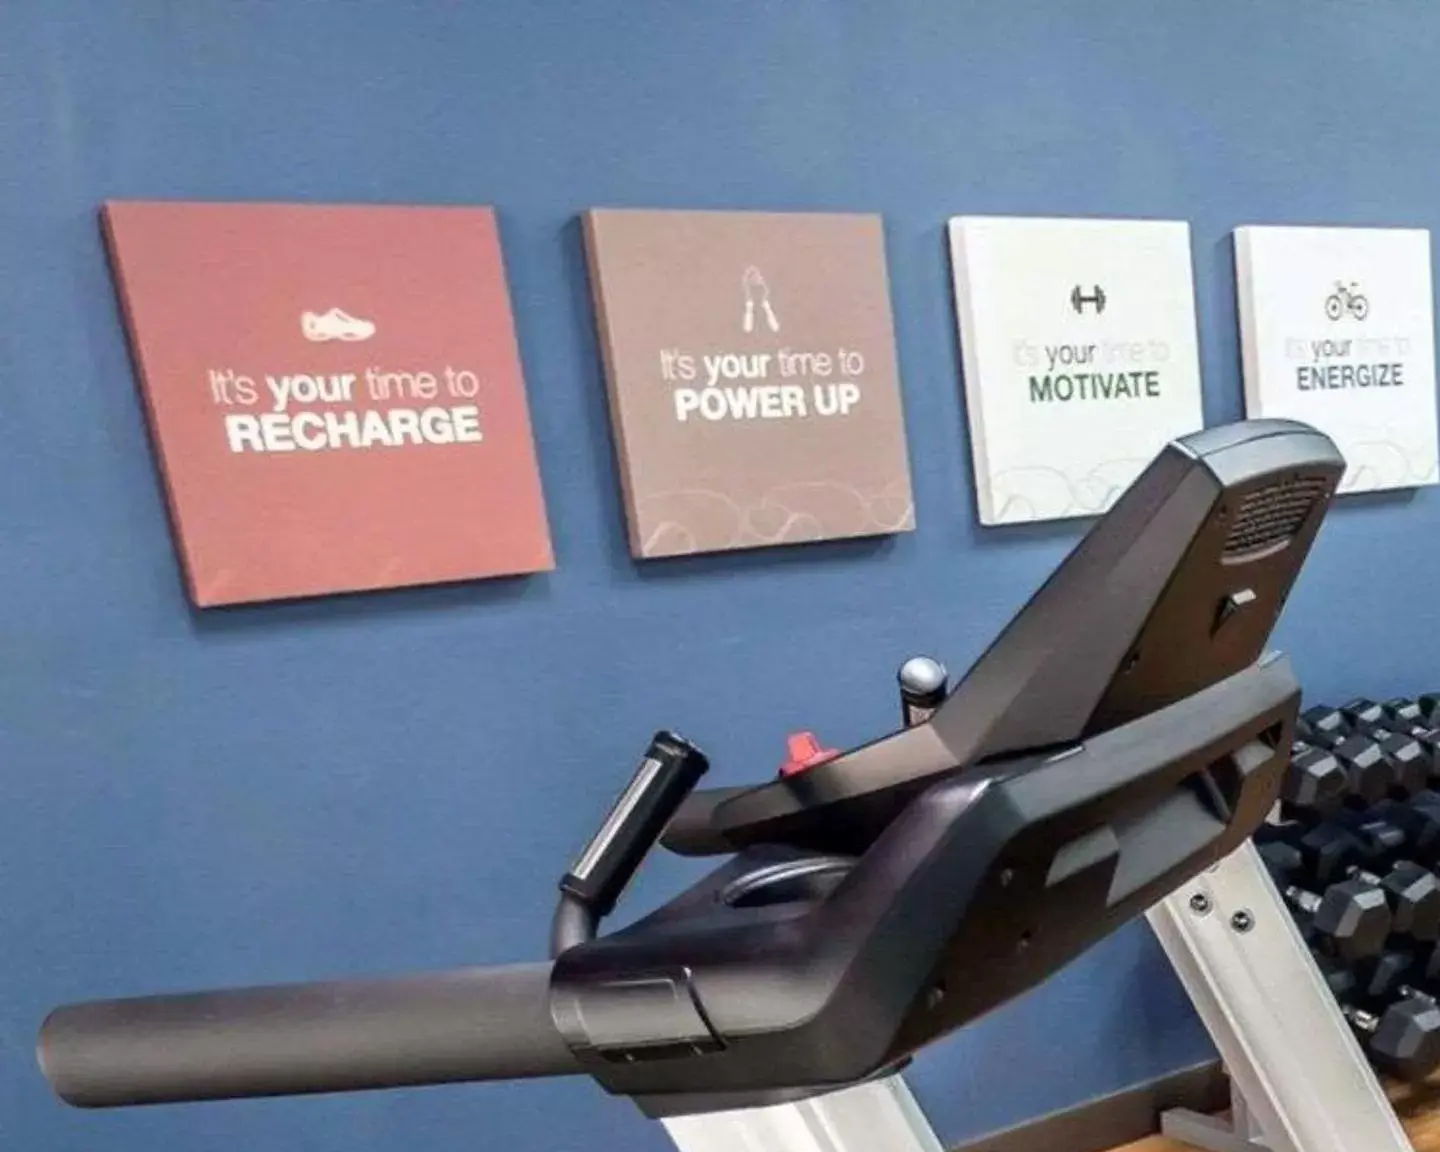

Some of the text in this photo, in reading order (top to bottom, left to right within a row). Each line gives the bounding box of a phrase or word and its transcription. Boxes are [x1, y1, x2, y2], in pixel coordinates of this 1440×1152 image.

[703, 352, 772, 386] your
[777, 347, 833, 379] time
[838, 347, 865, 377] to
[1045, 344, 1096, 372] your
[1311, 339, 1353, 363] your
[209, 365, 480, 411] It's your time to
[1028, 371, 1160, 403] MOTIVATE
[1296, 363, 1404, 391] ENERGIZE
[673, 384, 861, 421] POWER UP
[225, 406, 483, 453] RECHARGE
